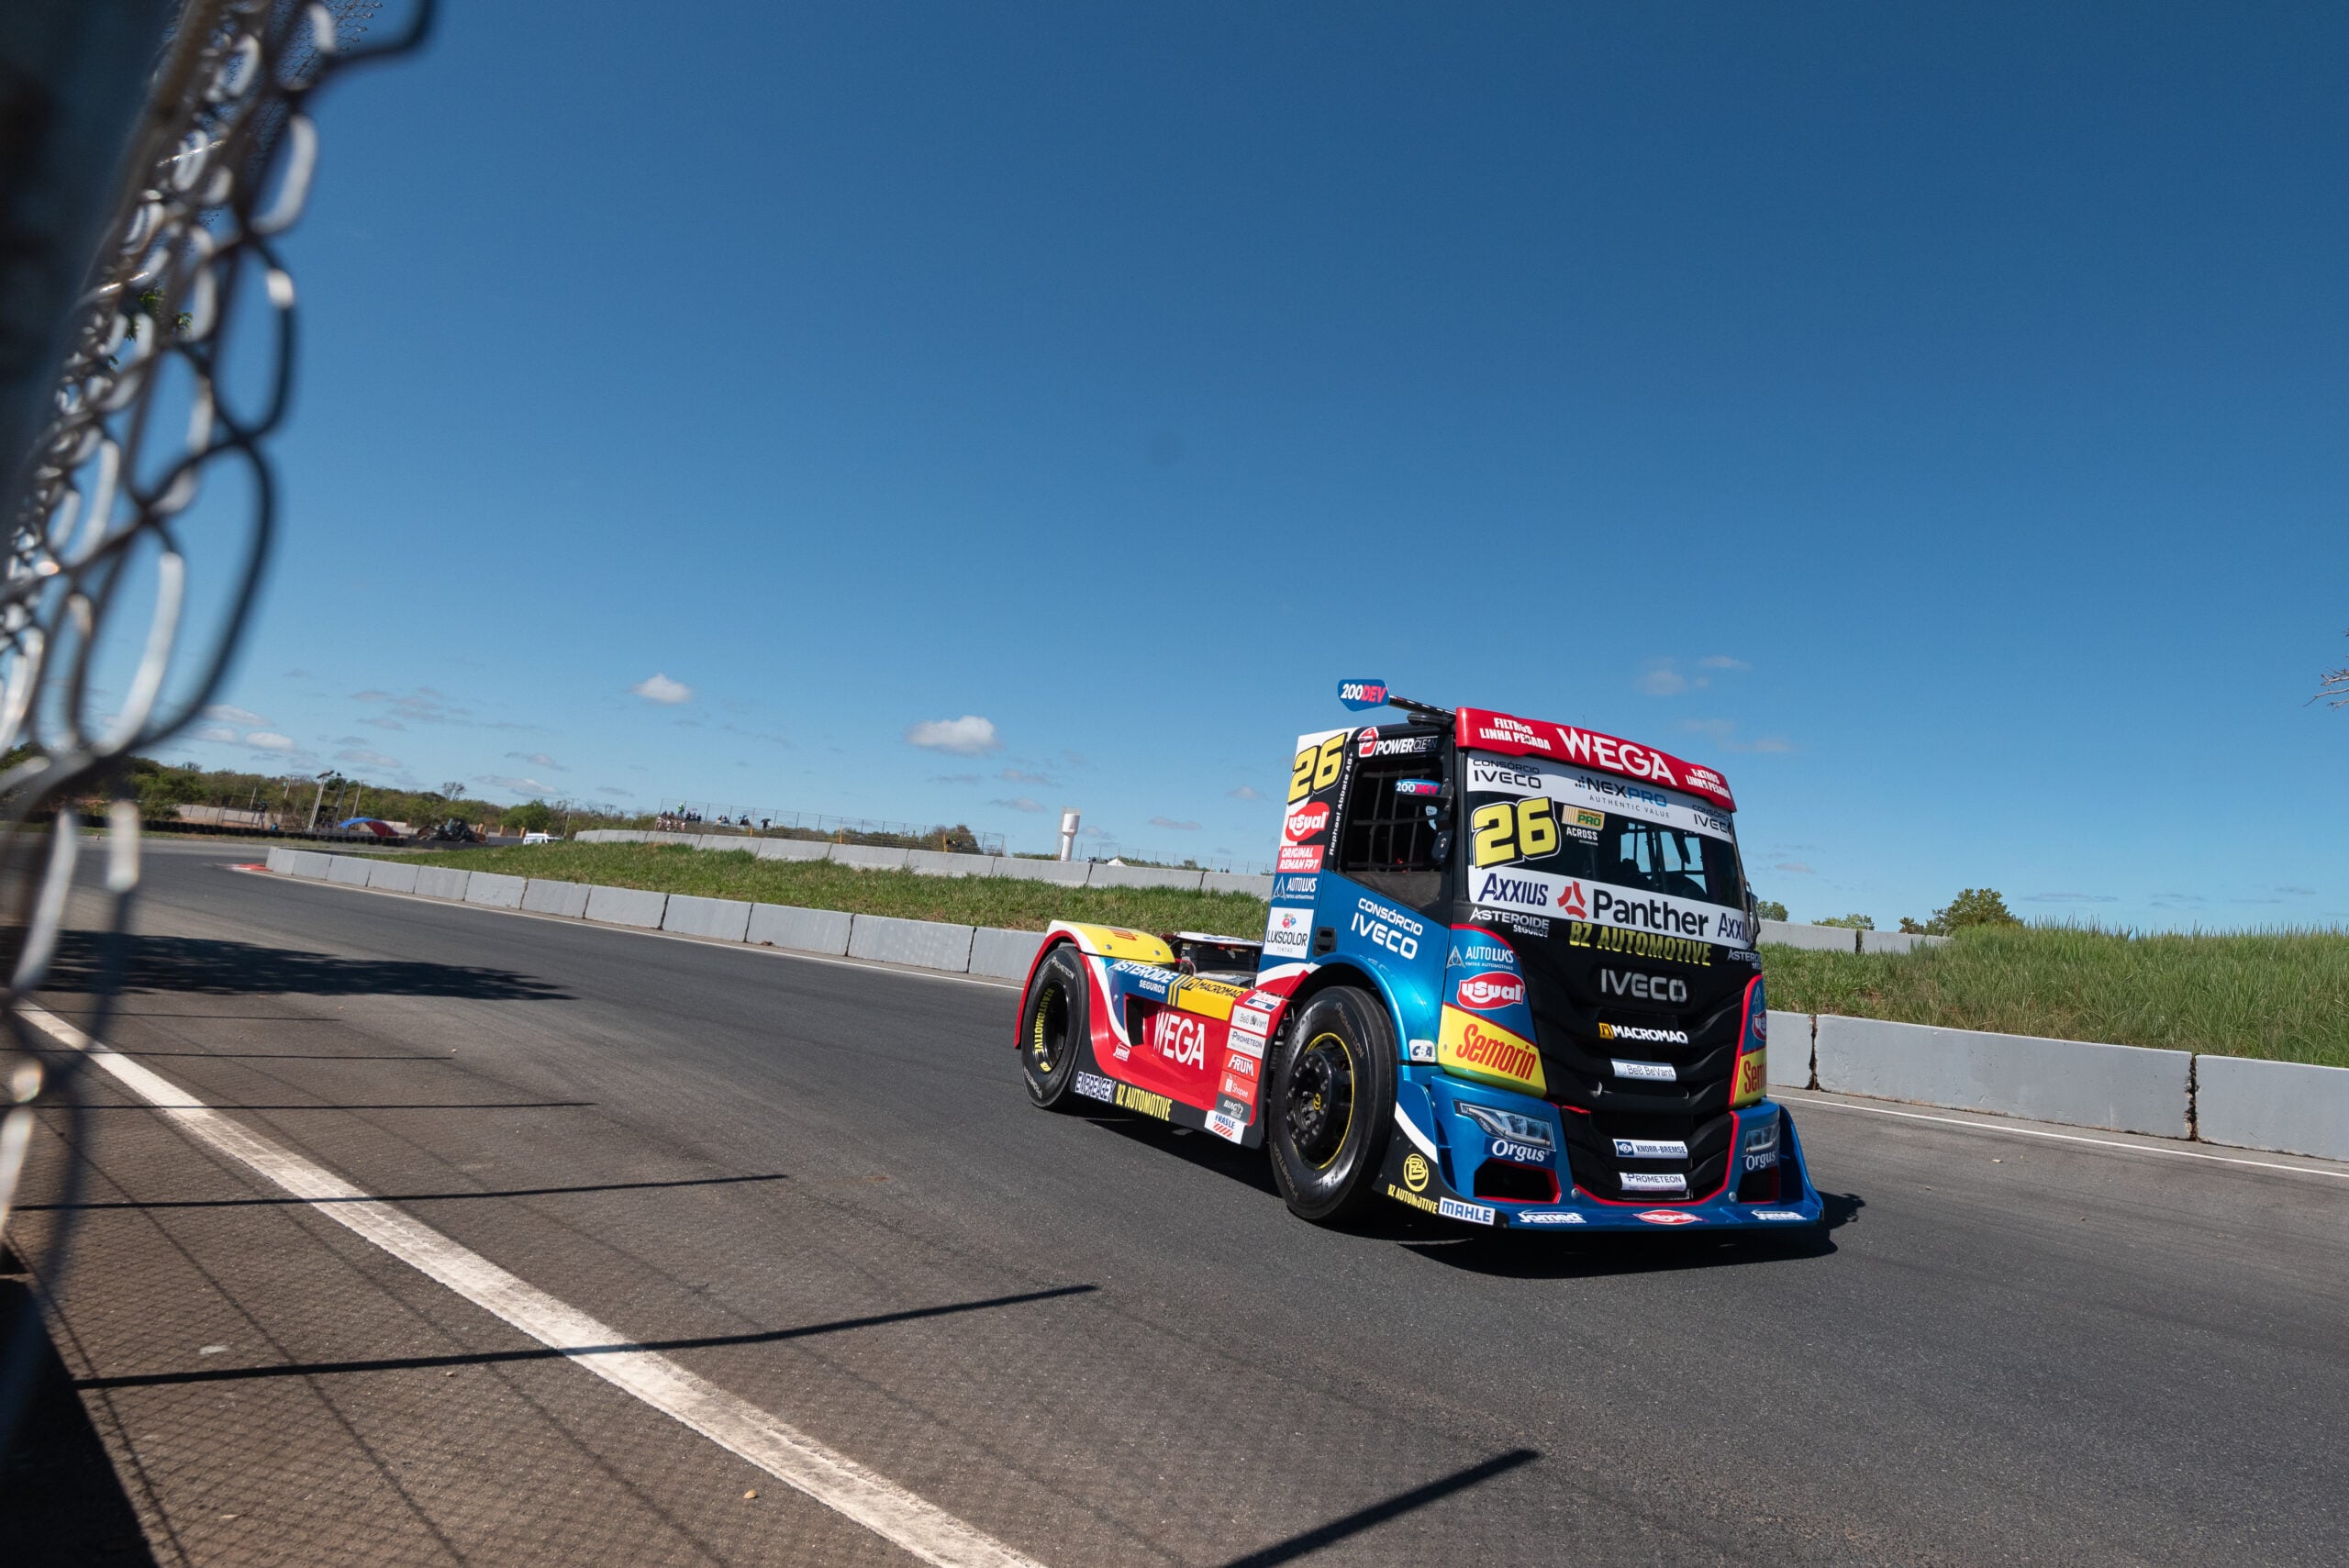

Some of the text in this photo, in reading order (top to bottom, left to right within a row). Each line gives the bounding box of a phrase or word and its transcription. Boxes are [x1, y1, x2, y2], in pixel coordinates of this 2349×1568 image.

[1340, 683, 1387, 704] 200DEV
[1478, 728, 1512, 742] LINHA
[1473, 759, 1540, 774] CONSÓRCIO
[1555, 727, 1678, 786] WEGA
[1287, 731, 1346, 805] 26
[1396, 783, 1440, 795] 200DEV
[1474, 770, 1542, 790] IVECO
[1586, 777, 1668, 807] NEXPRO
[1589, 795, 1671, 819] AUTHENTIC VALUE
[1288, 811, 1329, 837] usual
[1577, 815, 1601, 827] PRO
[1471, 795, 1561, 870] 26
[1566, 827, 1598, 841] ACROSS
[1282, 847, 1314, 858] ORIGINAL
[1279, 860, 1319, 870] REMAN FPT
[1358, 897, 1423, 936] CONSÓRCIO
[1468, 906, 1550, 930] ASTEROIDE
[1593, 888, 1709, 937] Panther
[1351, 912, 1419, 960] IVECO
[1513, 924, 1549, 938] SEGUROS
[1465, 946, 1514, 963] AUTOLUKS
[1569, 921, 1712, 966] BZ AUTOMOTIVE
[1107, 961, 1180, 984] ASTEROIDE
[1139, 979, 1166, 994] SEGUROS
[1462, 982, 1522, 1003] usual
[1600, 968, 1687, 1003] IVECO
[1153, 1010, 1205, 1071] WEGA
[1232, 1030, 1264, 1049] PROMETEON
[1455, 1023, 1537, 1081] Semorin
[1228, 1054, 1254, 1077] FRUM
[1646, 1067, 1674, 1077] BeVant
[1232, 1084, 1249, 1098] Shopee
[1125, 1086, 1173, 1122] AUTOMOTIVE
[1492, 1140, 1545, 1162] Orgus
[1635, 1144, 1687, 1154] KNORR-BREMSE
[1745, 1151, 1776, 1171] Orgus
[1626, 1173, 1682, 1184] PROMETEON
[1395, 1188, 1439, 1215] AUTOMOTIVE
[1442, 1201, 1492, 1224] MAHLE
